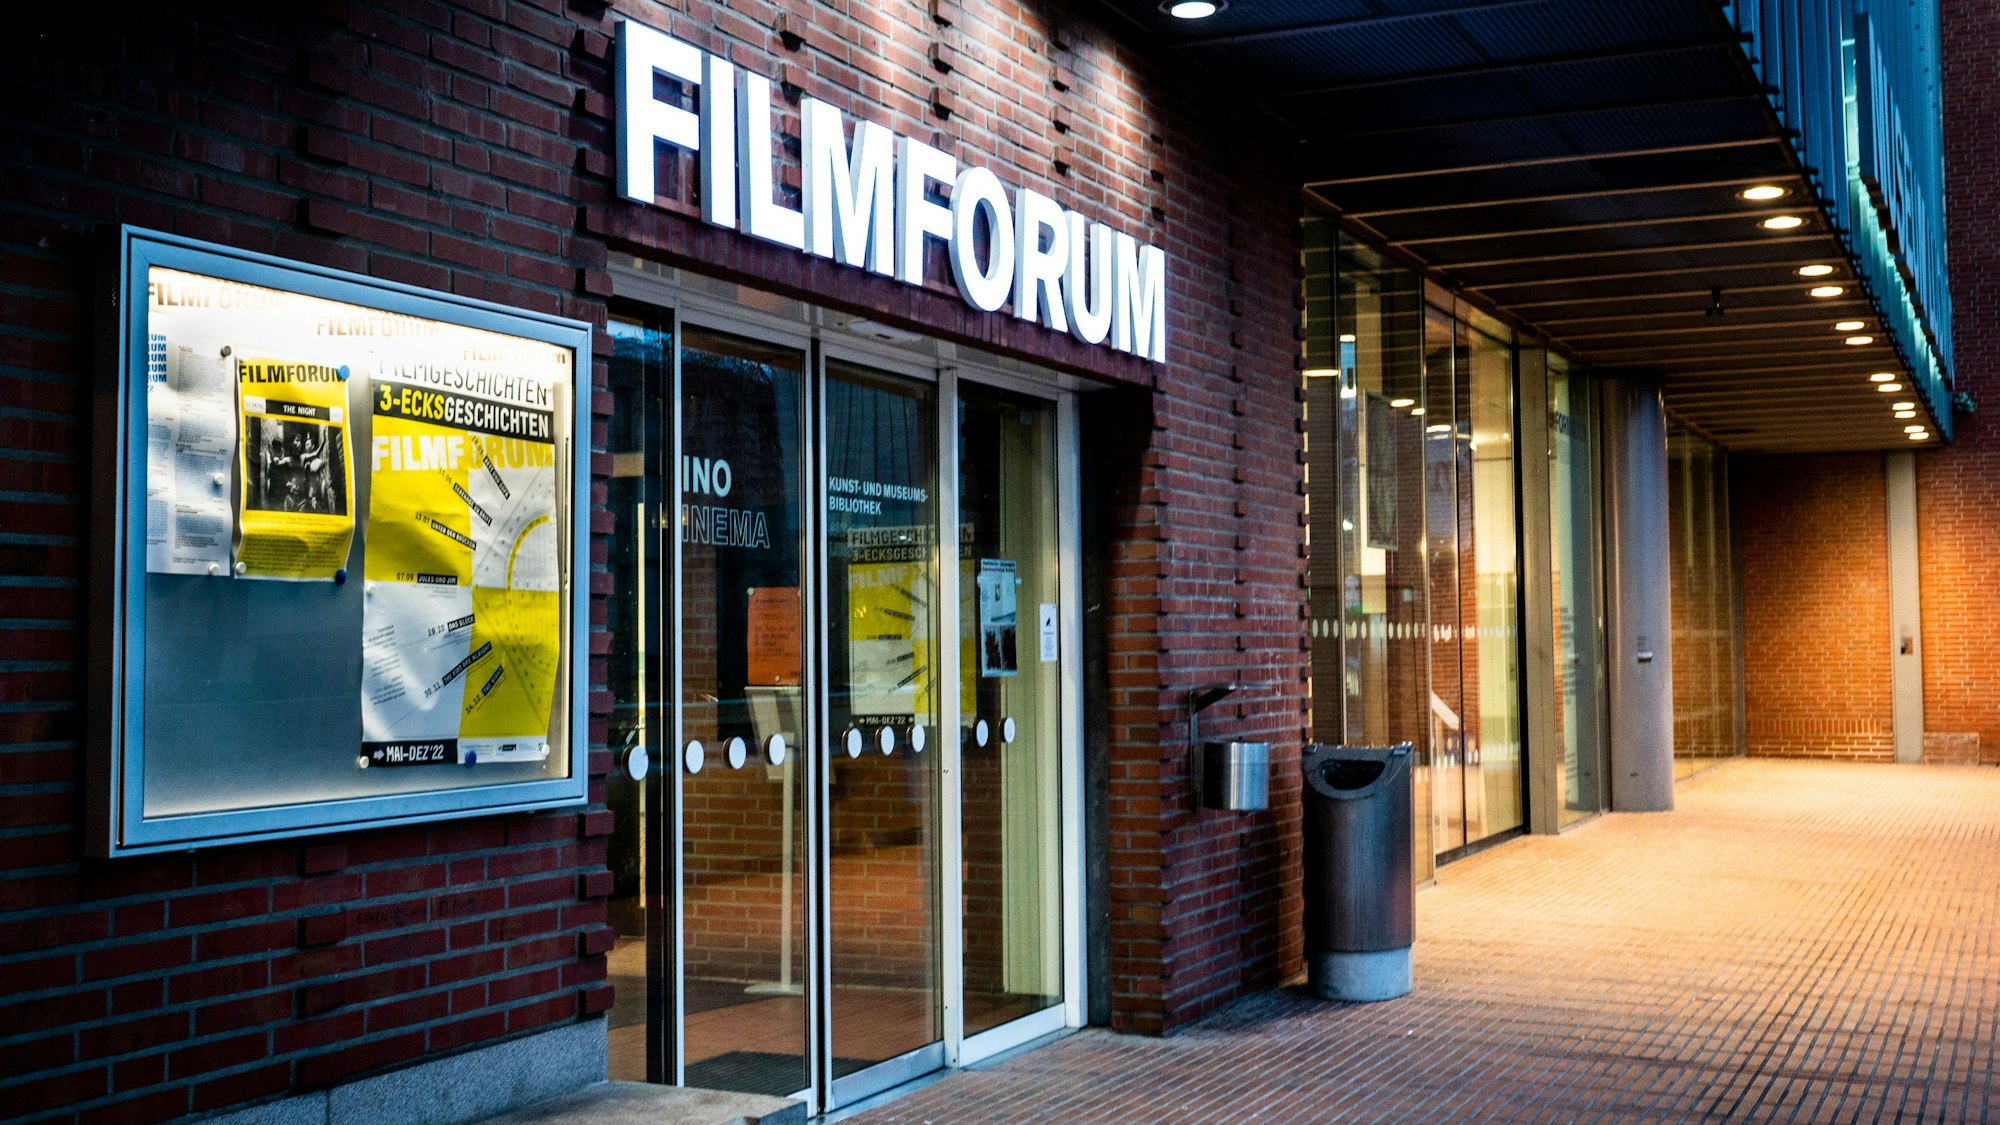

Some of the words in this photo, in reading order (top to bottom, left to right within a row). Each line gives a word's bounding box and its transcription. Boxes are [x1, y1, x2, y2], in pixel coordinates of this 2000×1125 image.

[615, 19, 1166, 364] FILMFORUM
[316, 314, 440, 337] FILMFORUM
[379, 358, 547, 406] FILMGESCHICHTEN
[283, 404, 296, 414] THE
[297, 406, 316, 416] NIGHT
[379, 384, 549, 438] 3-ECKSGESCHICHTEN
[371, 434, 553, 473] FILMFORUM
[683, 455, 732, 498] INO
[829, 476, 862, 494] KUNST-
[863, 480, 882, 497] UND
[883, 486, 928, 502] MUSEUMS-
[829, 496, 882, 515] BIBLIOTHEK
[682, 504, 770, 548] INEMA
[418, 575, 435, 583] JULES
